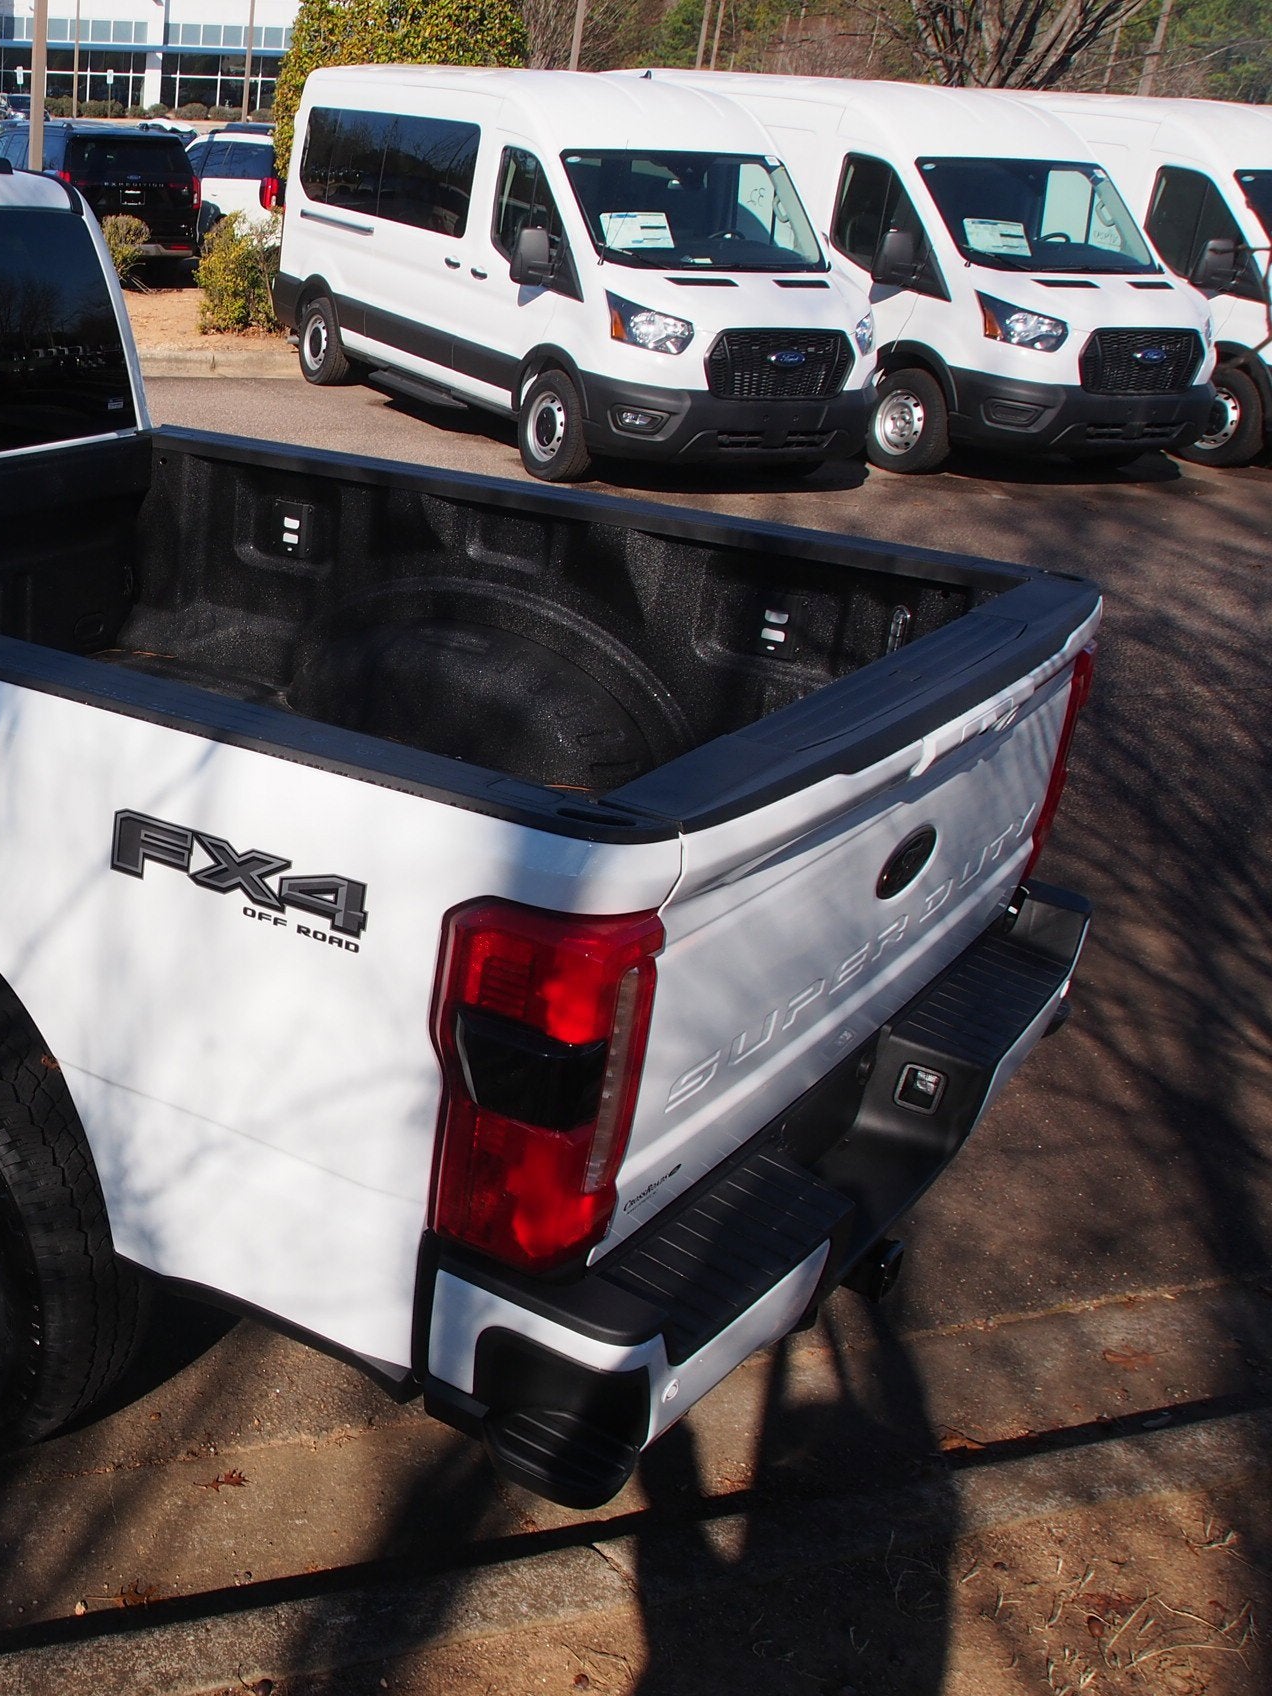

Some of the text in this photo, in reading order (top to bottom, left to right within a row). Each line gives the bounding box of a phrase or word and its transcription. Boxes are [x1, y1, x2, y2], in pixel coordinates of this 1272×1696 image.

[110, 808, 369, 940] FX4
[242, 906, 361, 955] OFF ROAD
[664, 801, 1036, 1114] SUPER DUTY
